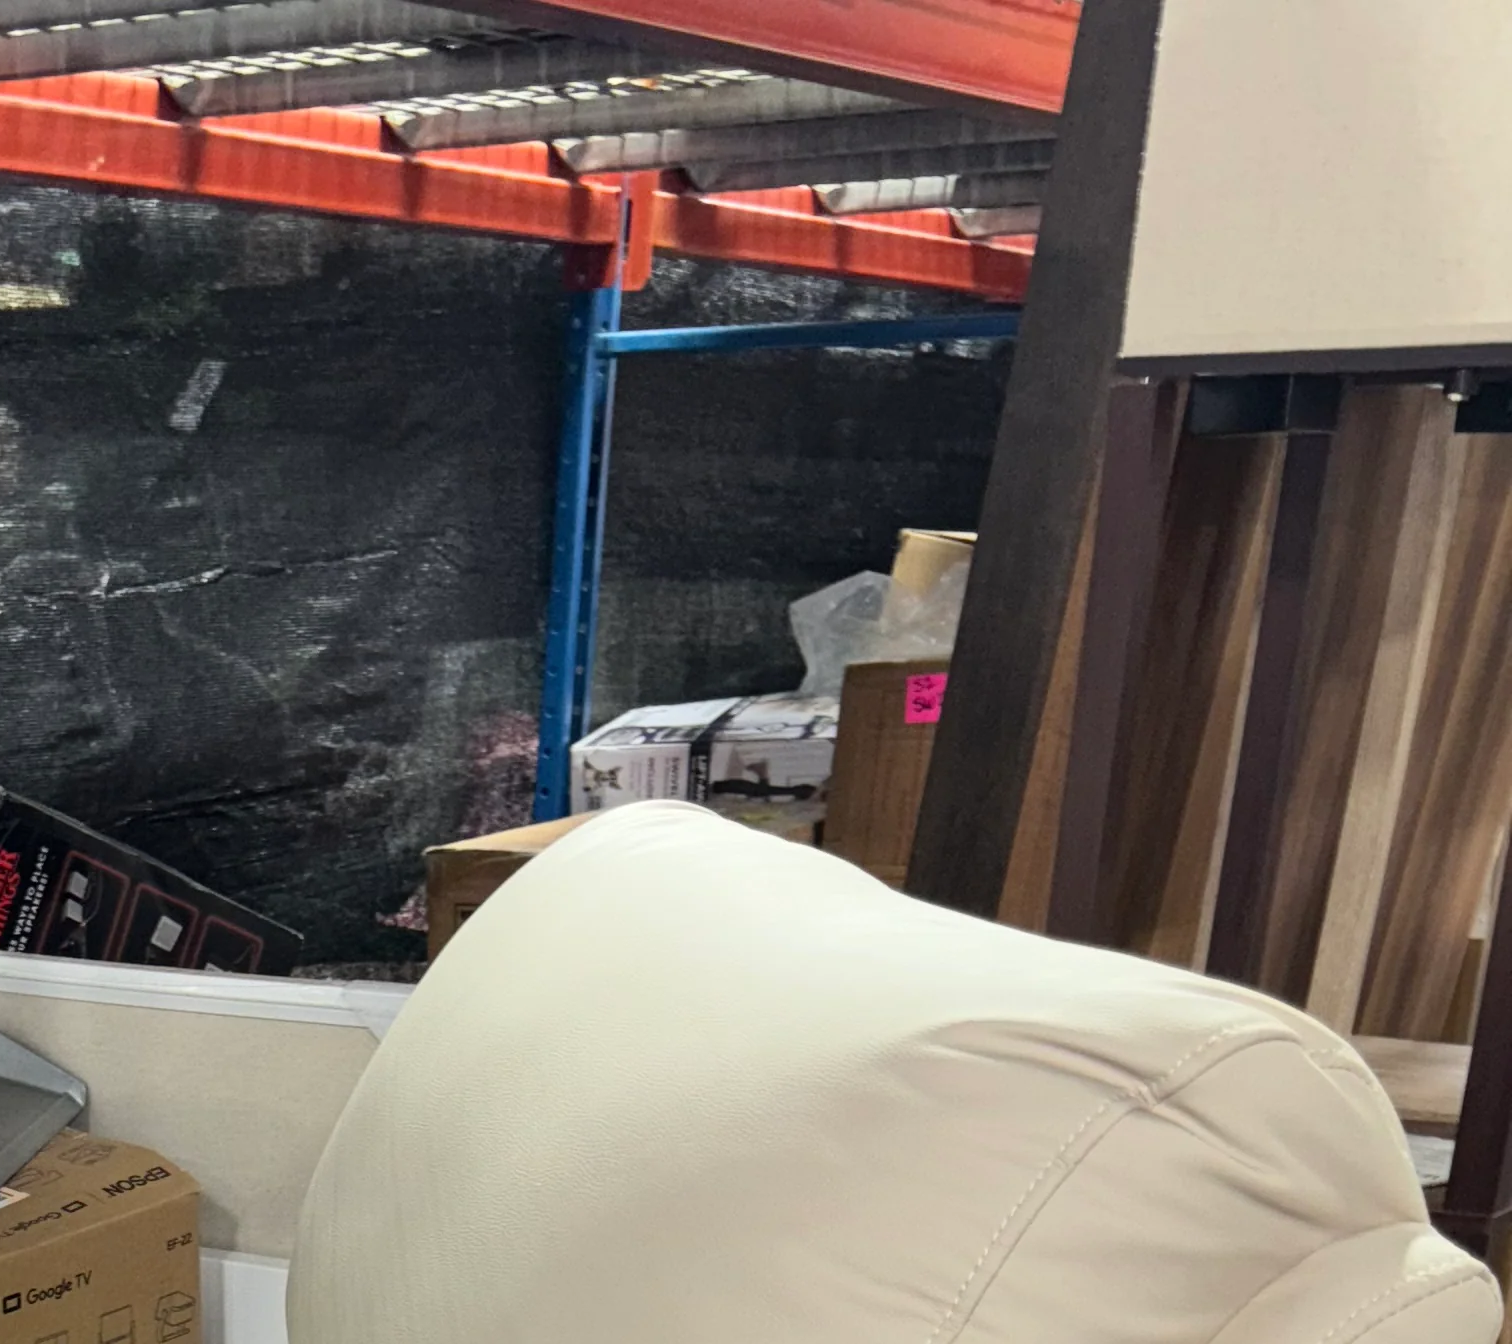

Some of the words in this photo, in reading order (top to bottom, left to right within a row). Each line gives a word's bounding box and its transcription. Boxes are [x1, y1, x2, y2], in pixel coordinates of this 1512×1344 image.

[13, 904, 30, 935] WAYS
[24, 886, 36, 900] TO
[30, 846, 49, 883] PLACE
[102, 1166, 171, 1197] EPSON
[26, 1278, 73, 1305] Google
[75, 1270, 93, 1288] TV
